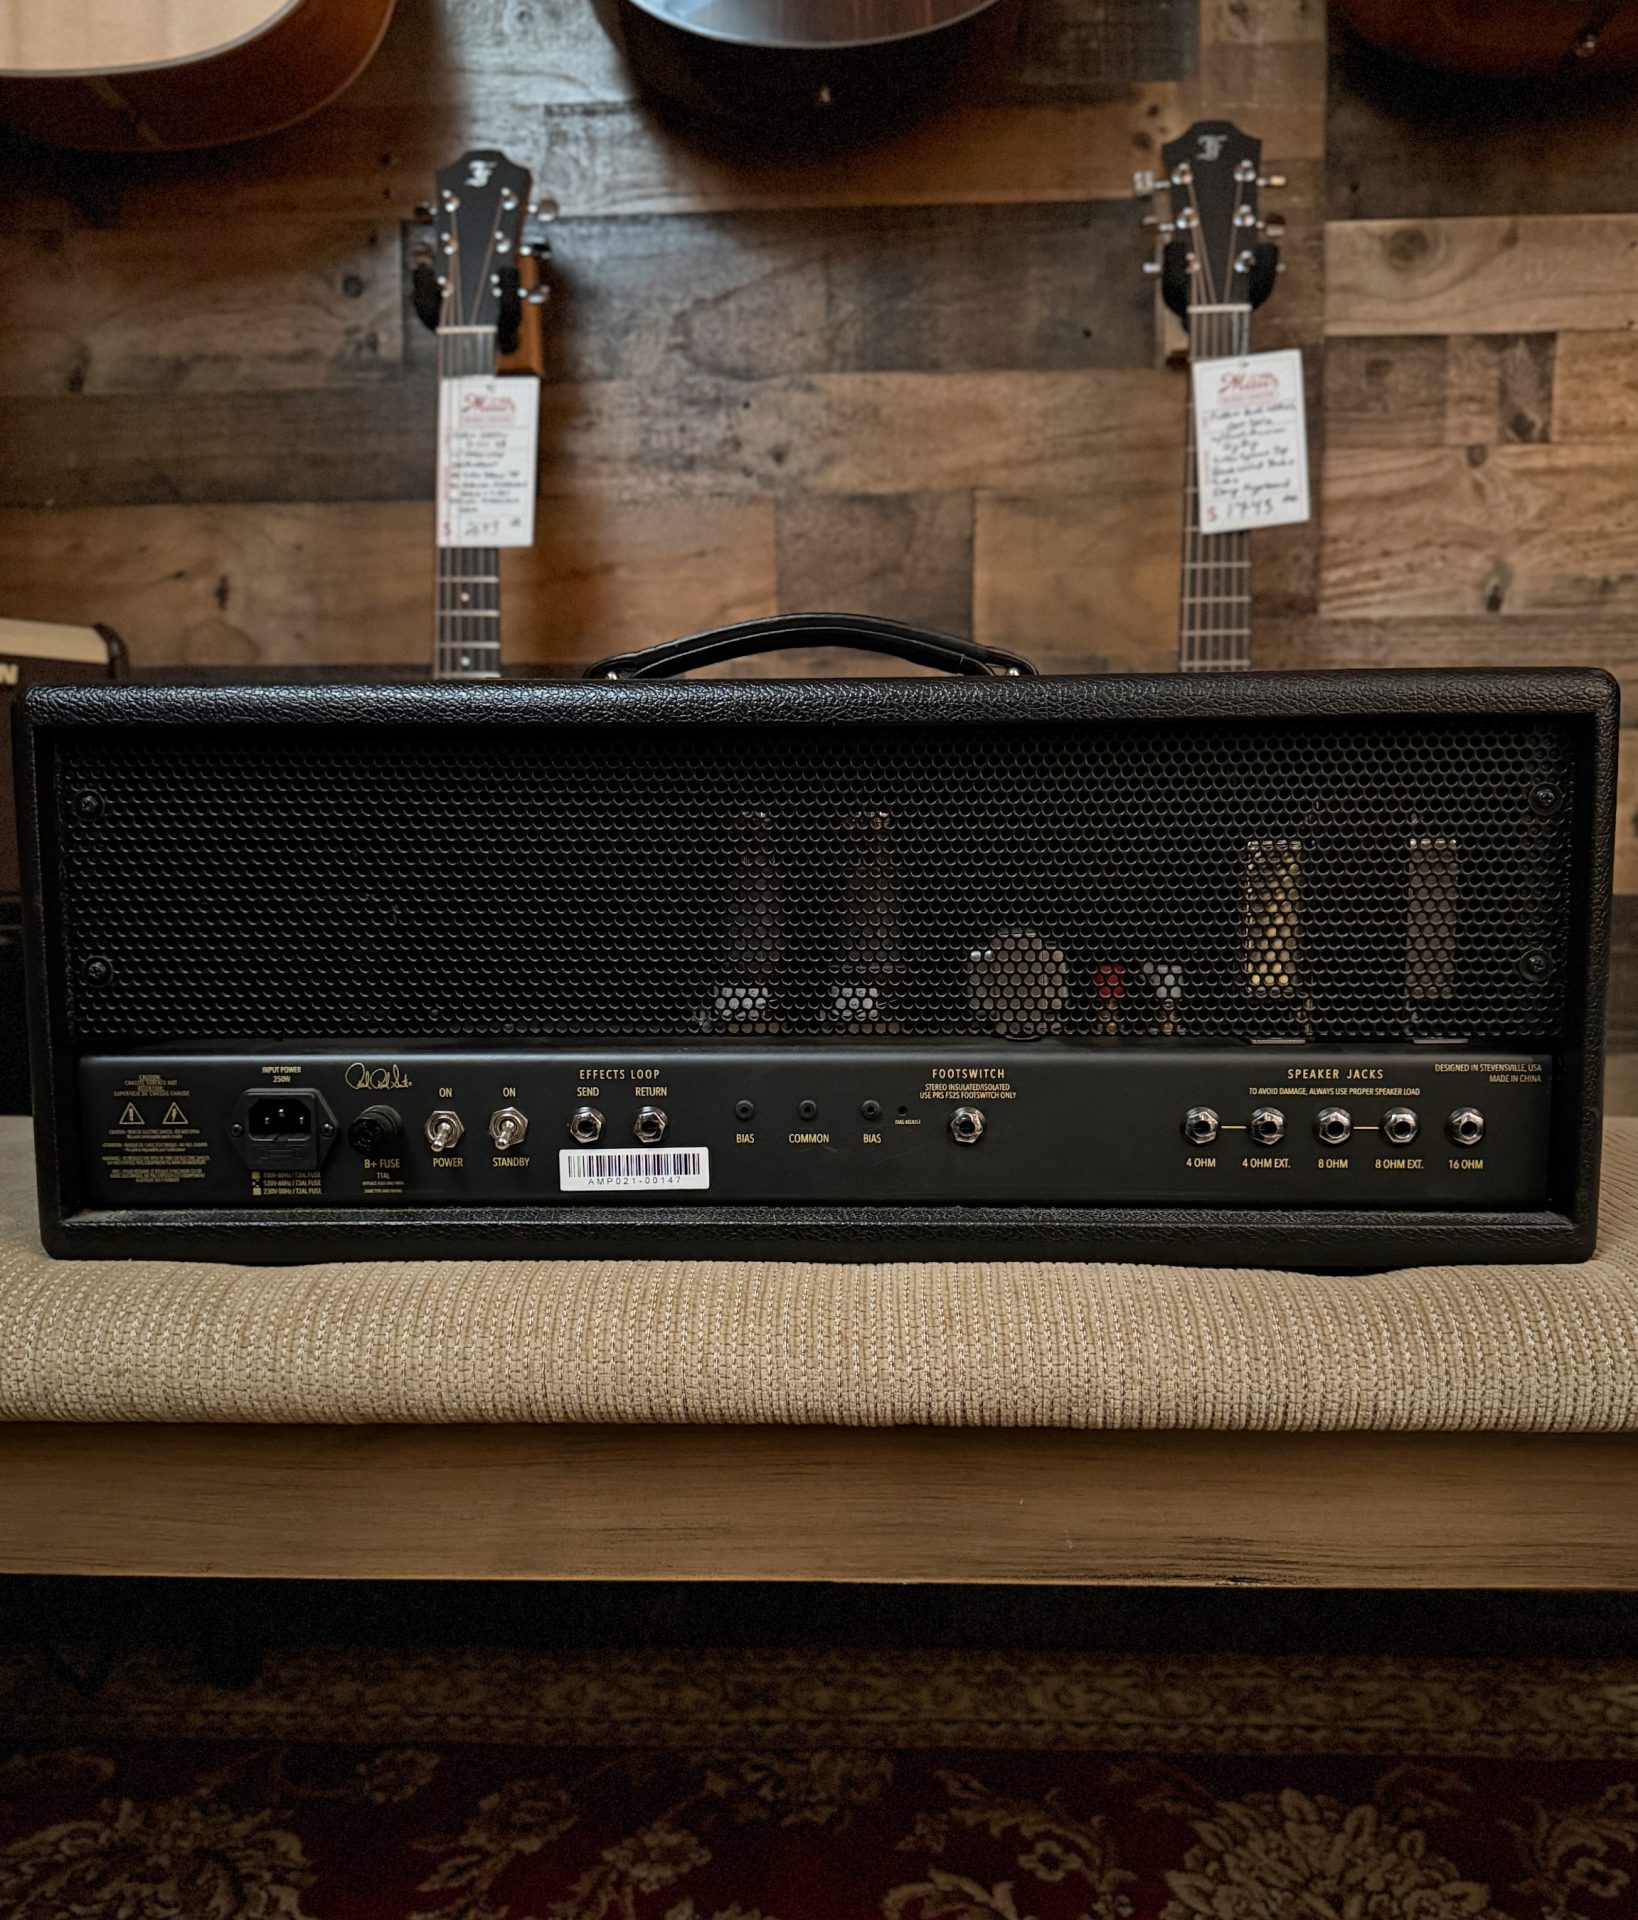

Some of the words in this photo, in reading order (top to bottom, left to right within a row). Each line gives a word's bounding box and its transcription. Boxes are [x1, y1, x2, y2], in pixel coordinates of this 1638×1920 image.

[1435, 1064, 1469, 1072] DESIGNED
[1471, 1064, 1478, 1072] IN
[1480, 1064, 1527, 1072] STEVENSVILLE,
[1528, 1064, 1542, 1072] USA
[580, 1069, 625, 1080] EFFECTS
[631, 1069, 660, 1080] LOOP
[932, 1069, 1005, 1079] FOOTSWITCH
[1287, 1069, 1339, 1079] SPEAKER
[1346, 1069, 1384, 1079] JACKS
[1489, 1074, 1510, 1082] MADE
[1511, 1074, 1518, 1082] IN
[1520, 1074, 1542, 1082] CHINA
[577, 1087, 599, 1096] SEND
[635, 1087, 667, 1096] RETURN
[925, 1083, 947, 1091] STEREO
[948, 1083, 1010, 1091] INSULATED/ISOLATED
[1249, 1087, 1258, 1095] TO
[1258, 1087, 1278, 1095] AVOID
[1279, 1087, 1308, 1096] DAMAGE,
[1309, 1087, 1334, 1095] ALWAYS
[1336, 1087, 1348, 1095] USE
[1349, 1087, 1374, 1095] PROPER
[1374, 1087, 1402, 1096] SPEAKER
[1403, 1087, 1420, 1096] LOAD
[439, 1088, 452, 1097] ON
[502, 1088, 516, 1097] ON
[736, 1134, 754, 1143] BIAS
[789, 1134, 830, 1143] COMMON
[863, 1134, 882, 1143] BIAS
[364, 1159, 377, 1168] B+
[380, 1159, 400, 1168] FUSE
[433, 1158, 464, 1167] POWER
[492, 1157, 530, 1167] STANDBY
[1186, 1158, 1192, 1168] 4
[1194, 1158, 1216, 1168] OHM
[1242, 1158, 1248, 1168] 4
[1250, 1158, 1272, 1168] OHM
[1274, 1158, 1291, 1168] EXT.
[1318, 1159, 1324, 1169] 8
[1326, 1159, 1348, 1169] OHM
[1375, 1159, 1381, 1169] 8
[1383, 1159, 1405, 1169] OHM
[1407, 1159, 1424, 1169] EXT.
[1448, 1159, 1459, 1169] 16
[1461, 1159, 1483, 1169] OHM
[588, 1177, 681, 1185] AMP021-00147
